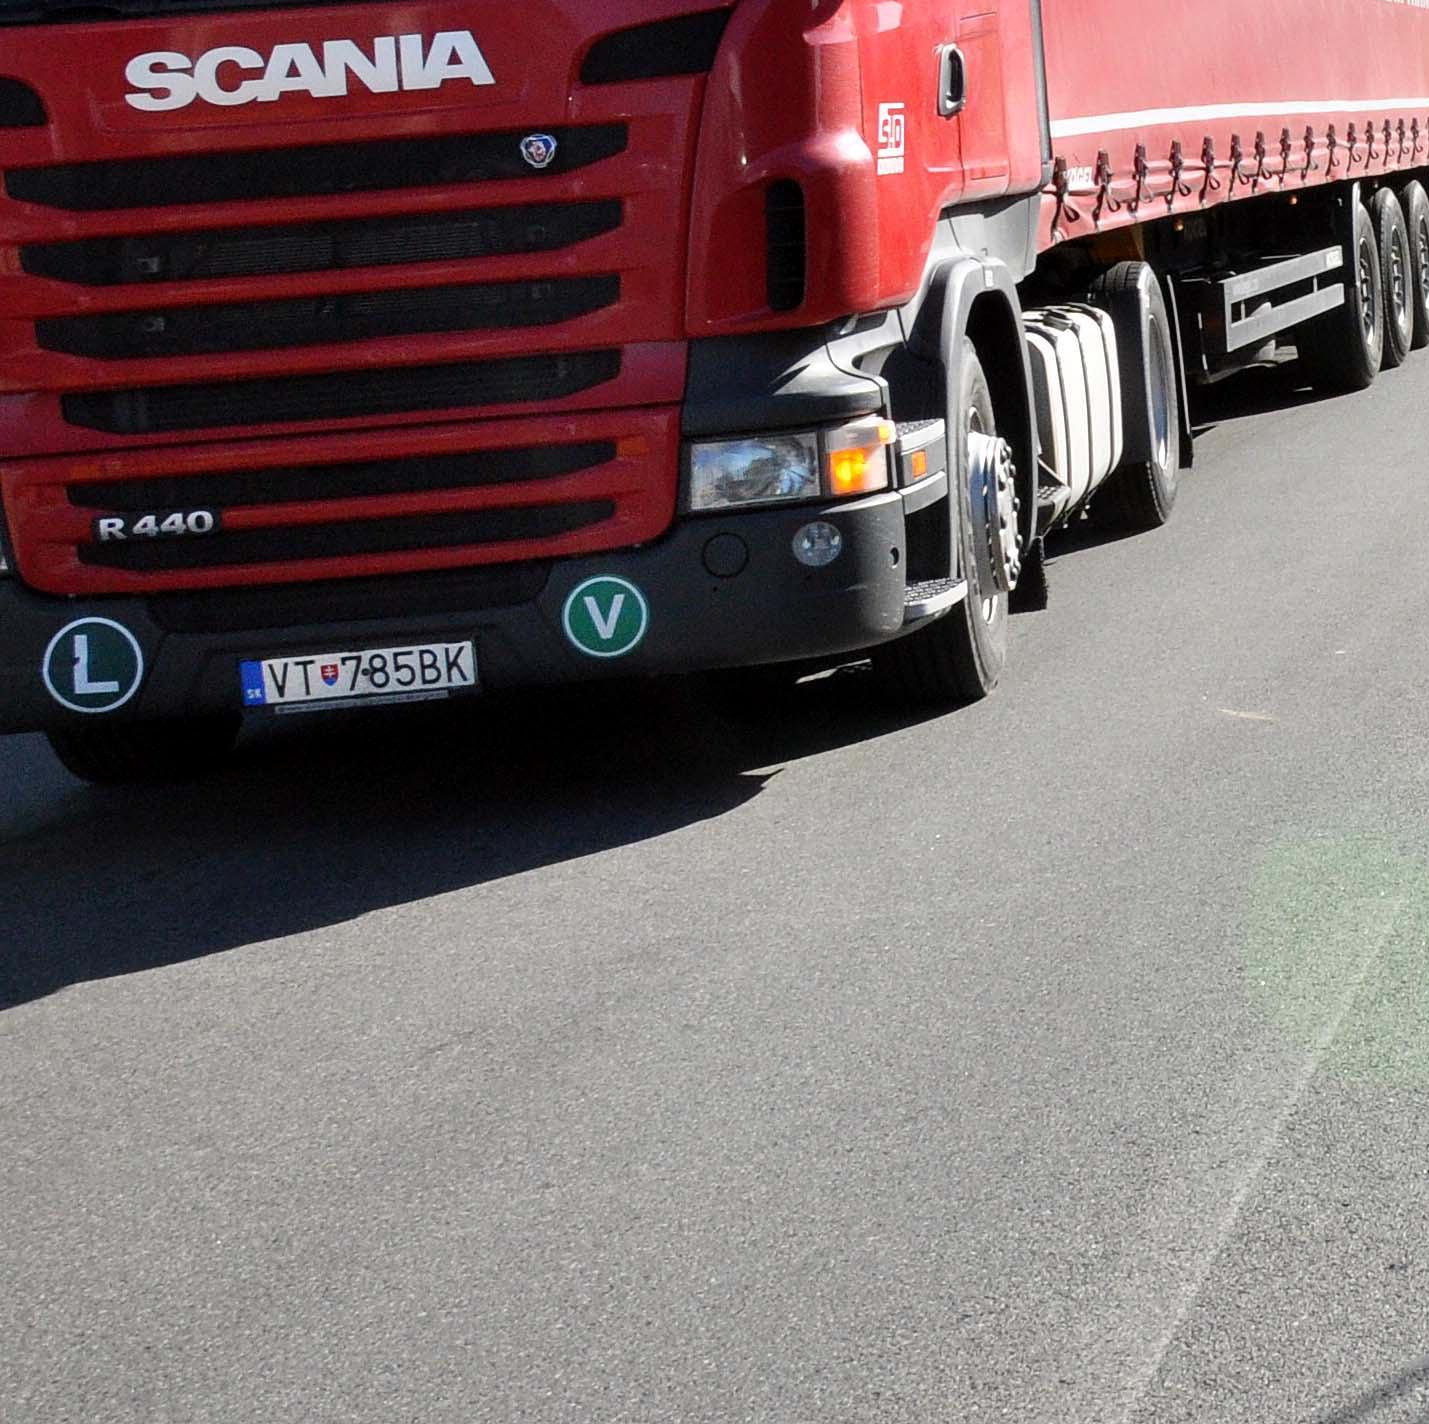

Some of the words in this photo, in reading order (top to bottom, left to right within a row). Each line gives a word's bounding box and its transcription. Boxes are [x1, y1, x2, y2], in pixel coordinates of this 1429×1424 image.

[124, 30, 496, 112] SCANIA
[99, 518, 127, 541] R
[132, 510, 214, 536] 440
[583, 594, 624, 640] V
[73, 634, 119, 694] L
[268, 659, 315, 698] VT
[341, 645, 468, 692] 785BK
